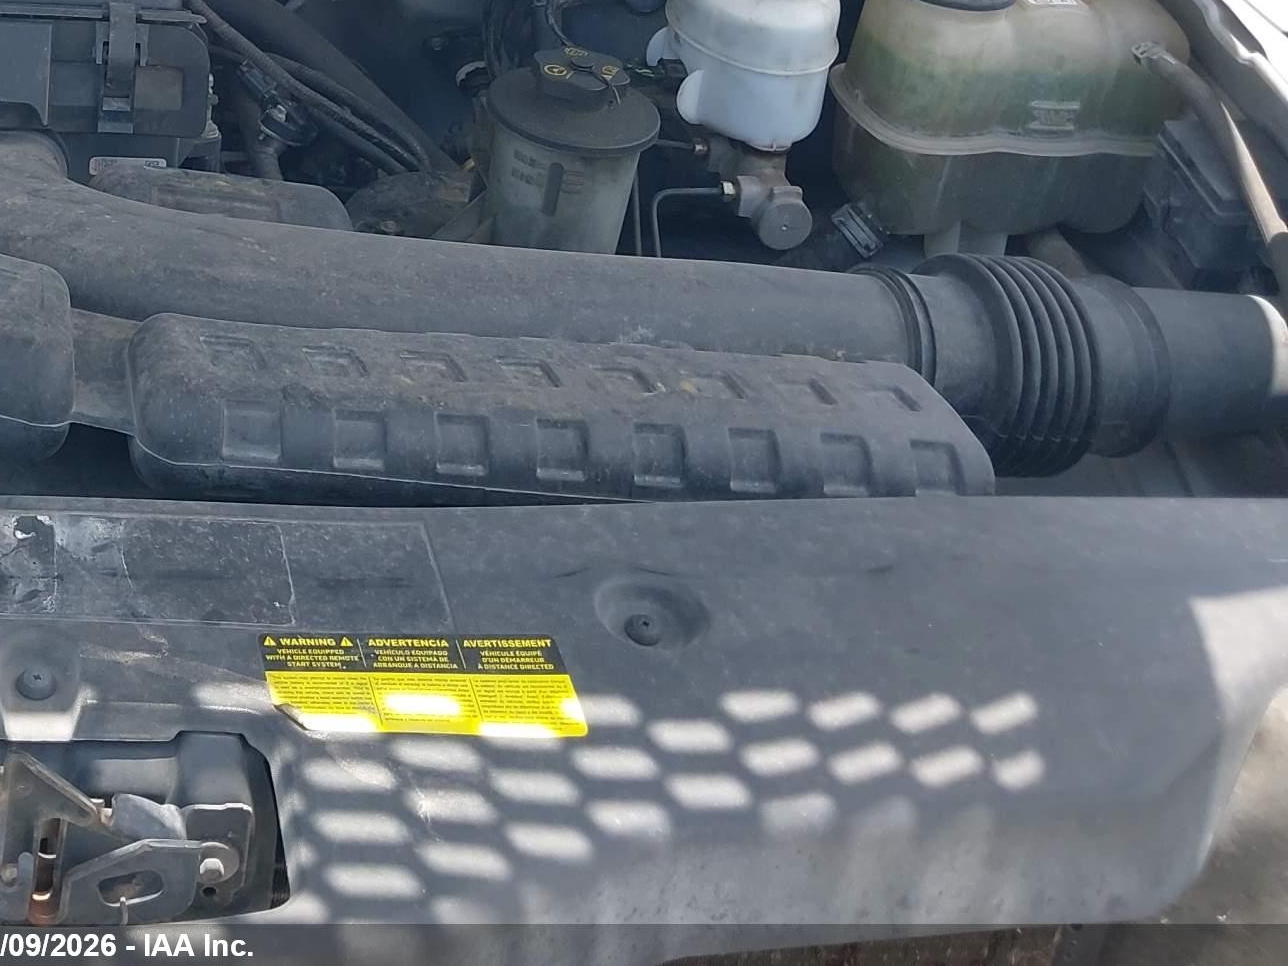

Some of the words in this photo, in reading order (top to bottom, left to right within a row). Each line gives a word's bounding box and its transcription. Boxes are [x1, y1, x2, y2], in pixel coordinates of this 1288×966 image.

[279, 638, 336, 646] WARNING
[368, 639, 449, 647] ADVERTENCIA
[463, 639, 552, 648] AVERTISSEMENT
[479, 649, 514, 657] VÉHICULE
